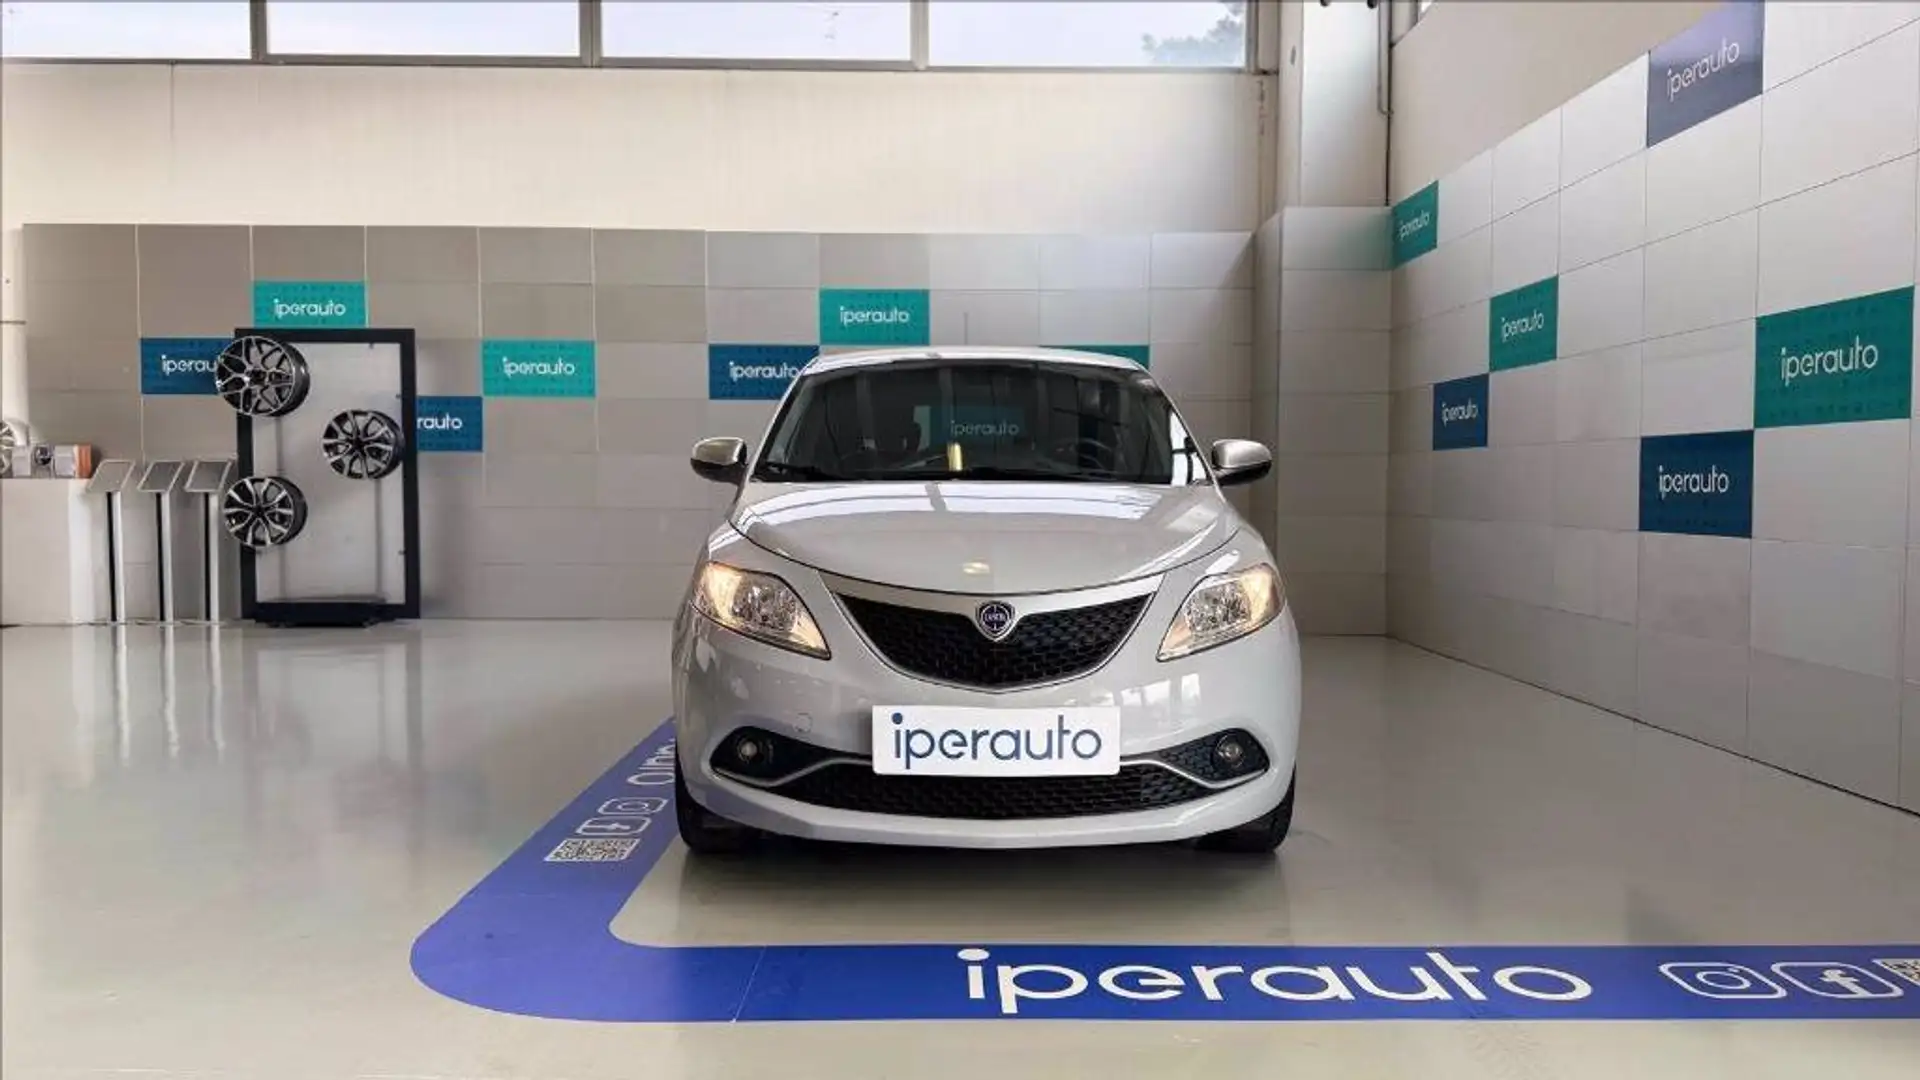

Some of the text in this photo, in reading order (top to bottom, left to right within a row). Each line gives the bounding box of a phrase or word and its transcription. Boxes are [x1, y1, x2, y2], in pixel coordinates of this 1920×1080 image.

[1666, 39, 1740, 101] iperauto
[274, 297, 346, 318] iperauto
[840, 305, 909, 326] iperauto
[1500, 310, 1544, 338] iperauto
[502, 357, 575, 378] iperauto
[729, 361, 799, 381] iperauto
[1781, 335, 1879, 385] iperauto
[1441, 398, 1478, 425] iperauto
[951, 419, 1019, 439] iperauto
[1659, 465, 1729, 499] iperauto
[892, 712, 1102, 769] iperauto
[958, 949, 1593, 1014] iperauto
